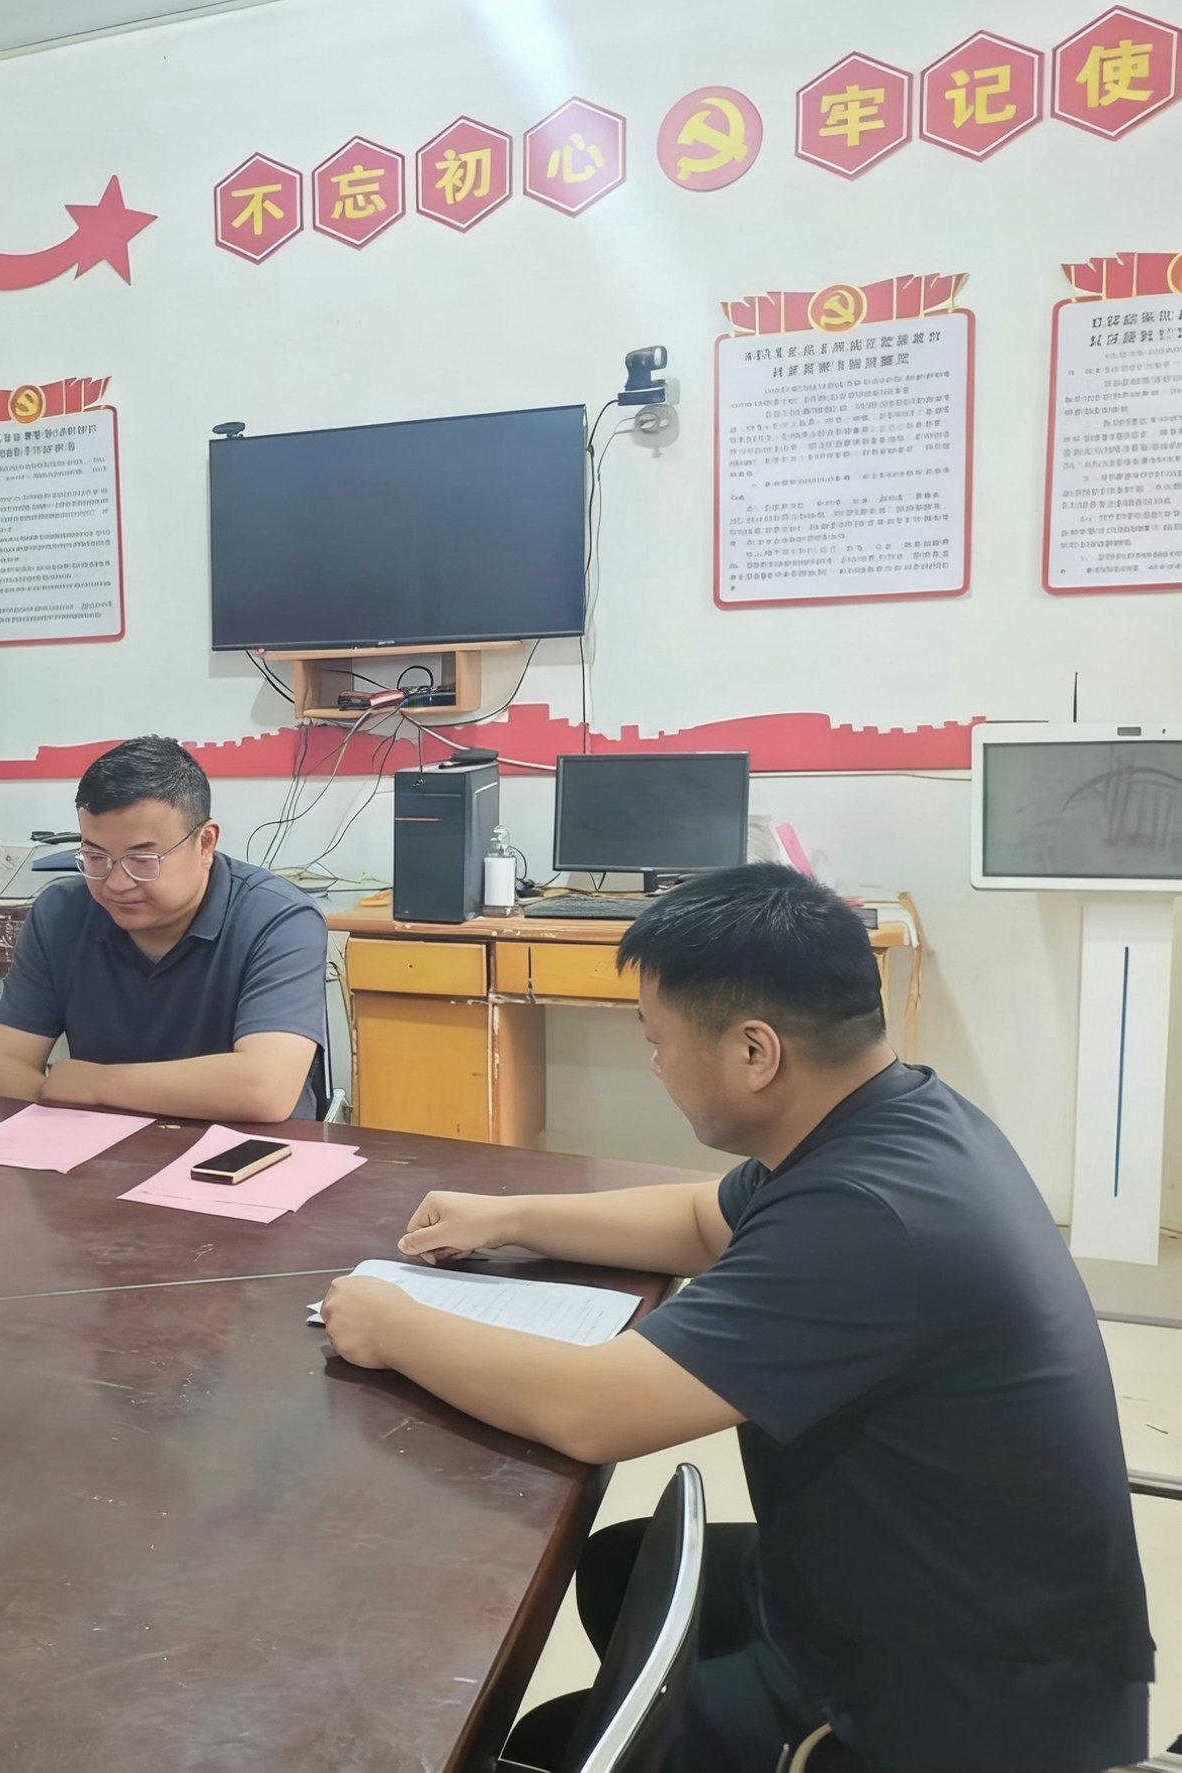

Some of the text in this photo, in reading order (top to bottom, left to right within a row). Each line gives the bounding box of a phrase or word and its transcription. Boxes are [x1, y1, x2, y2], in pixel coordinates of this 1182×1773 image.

[230, 41, 1155, 235] 不忘初心 牢记使
